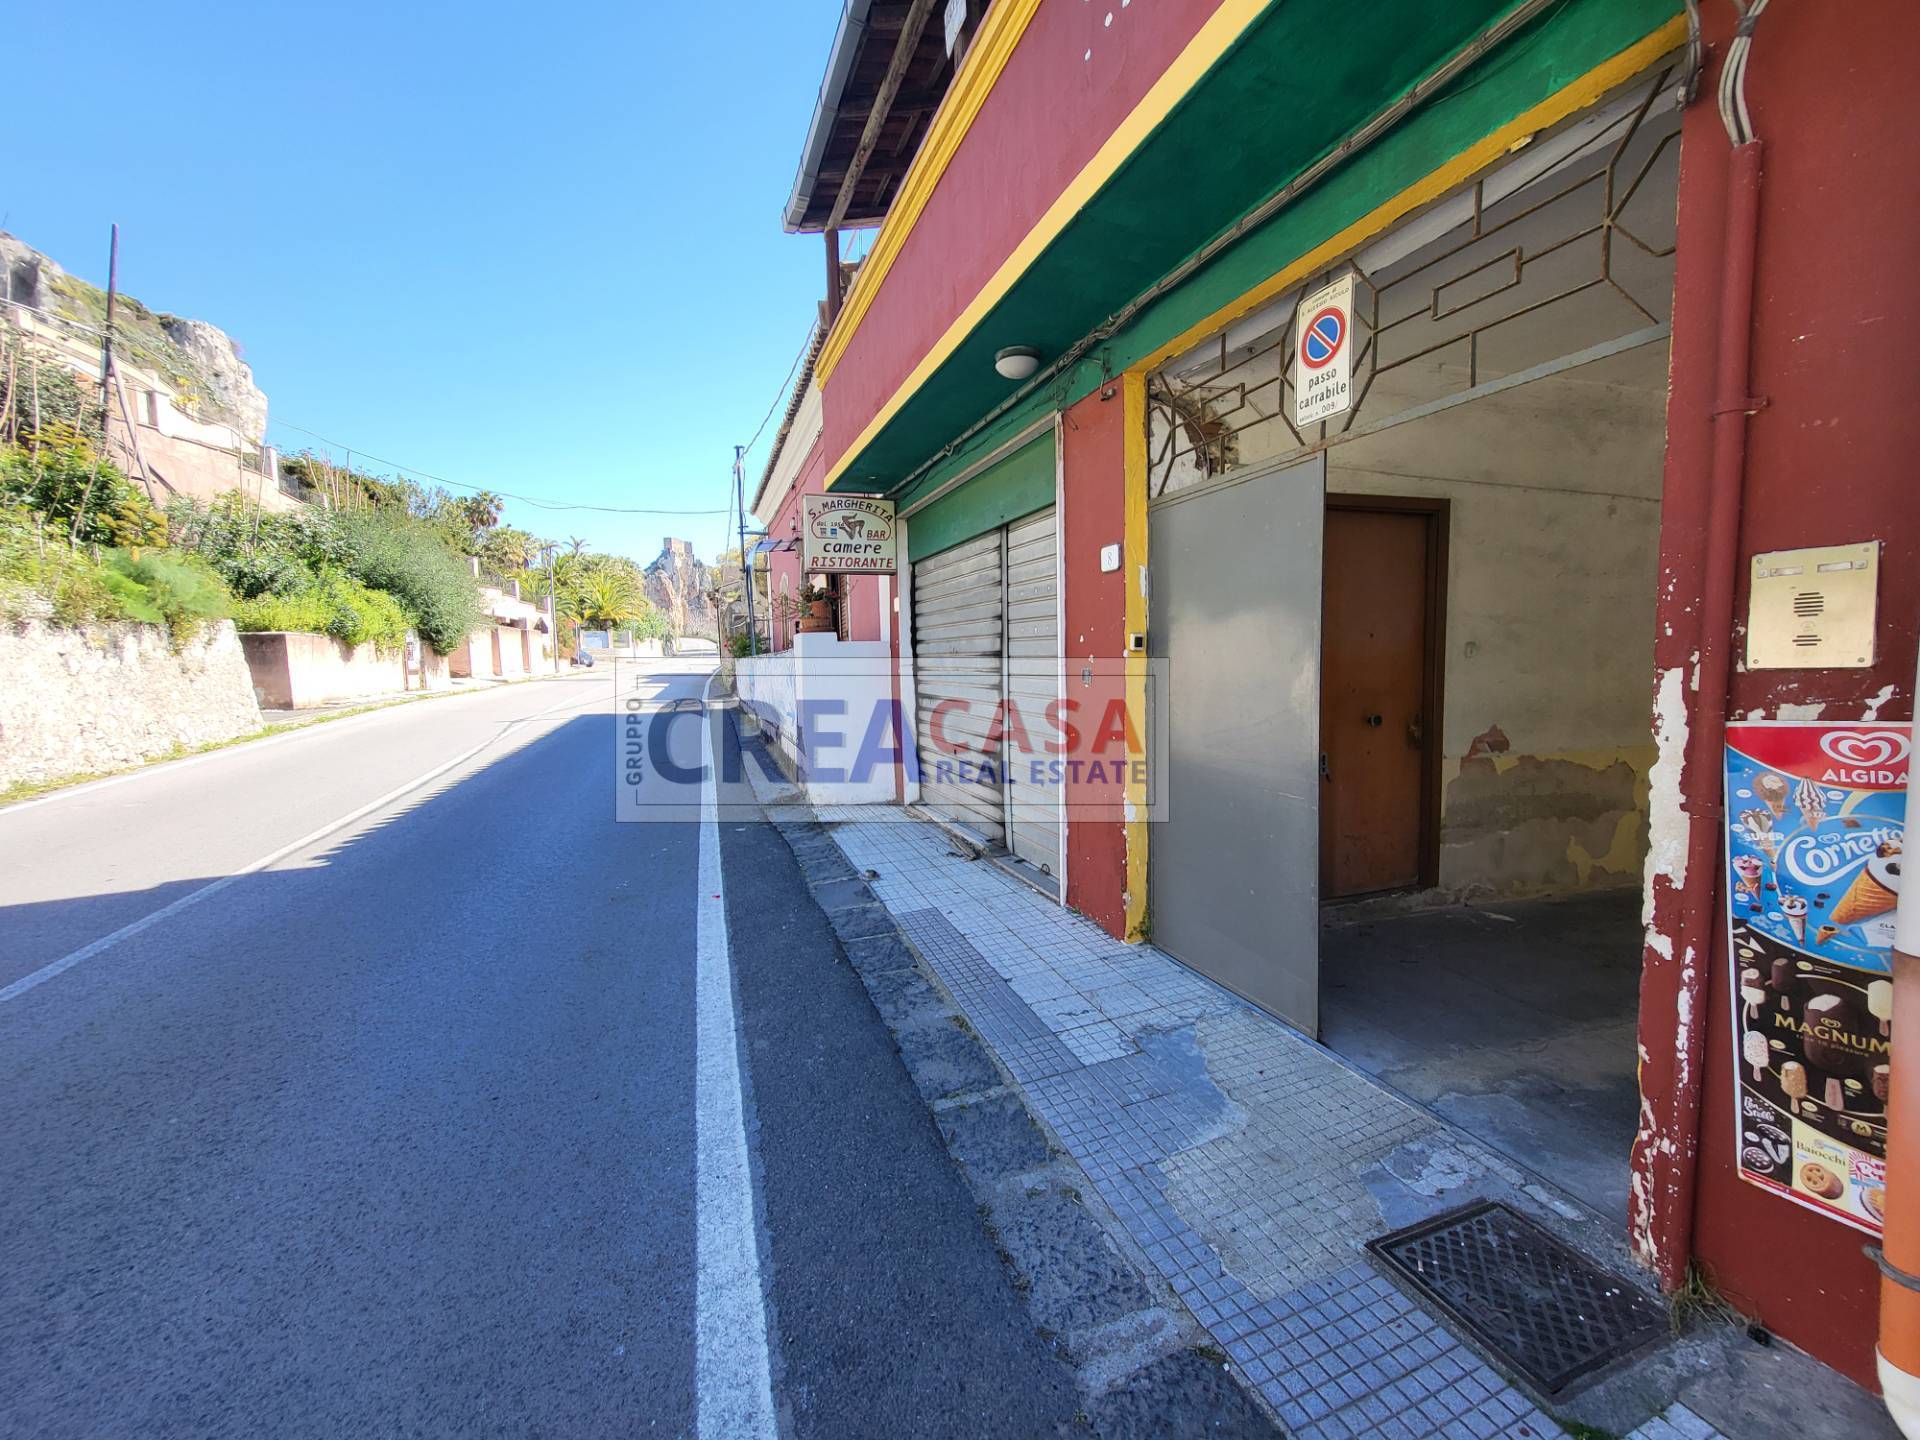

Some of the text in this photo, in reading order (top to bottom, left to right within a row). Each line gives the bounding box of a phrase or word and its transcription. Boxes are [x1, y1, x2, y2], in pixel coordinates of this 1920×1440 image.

[1308, 368, 1337, 391] passo
[1299, 381, 1347, 410] carrabile
[867, 529, 886, 539] BAR
[823, 542, 882, 554] camere
[811, 556, 894, 568] RISTORANTE
[1822, 768, 1909, 785] ALGIDA
[1774, 1012, 1892, 1056] MAGNUM
[1796, 1140, 1846, 1167] Baiocchi
